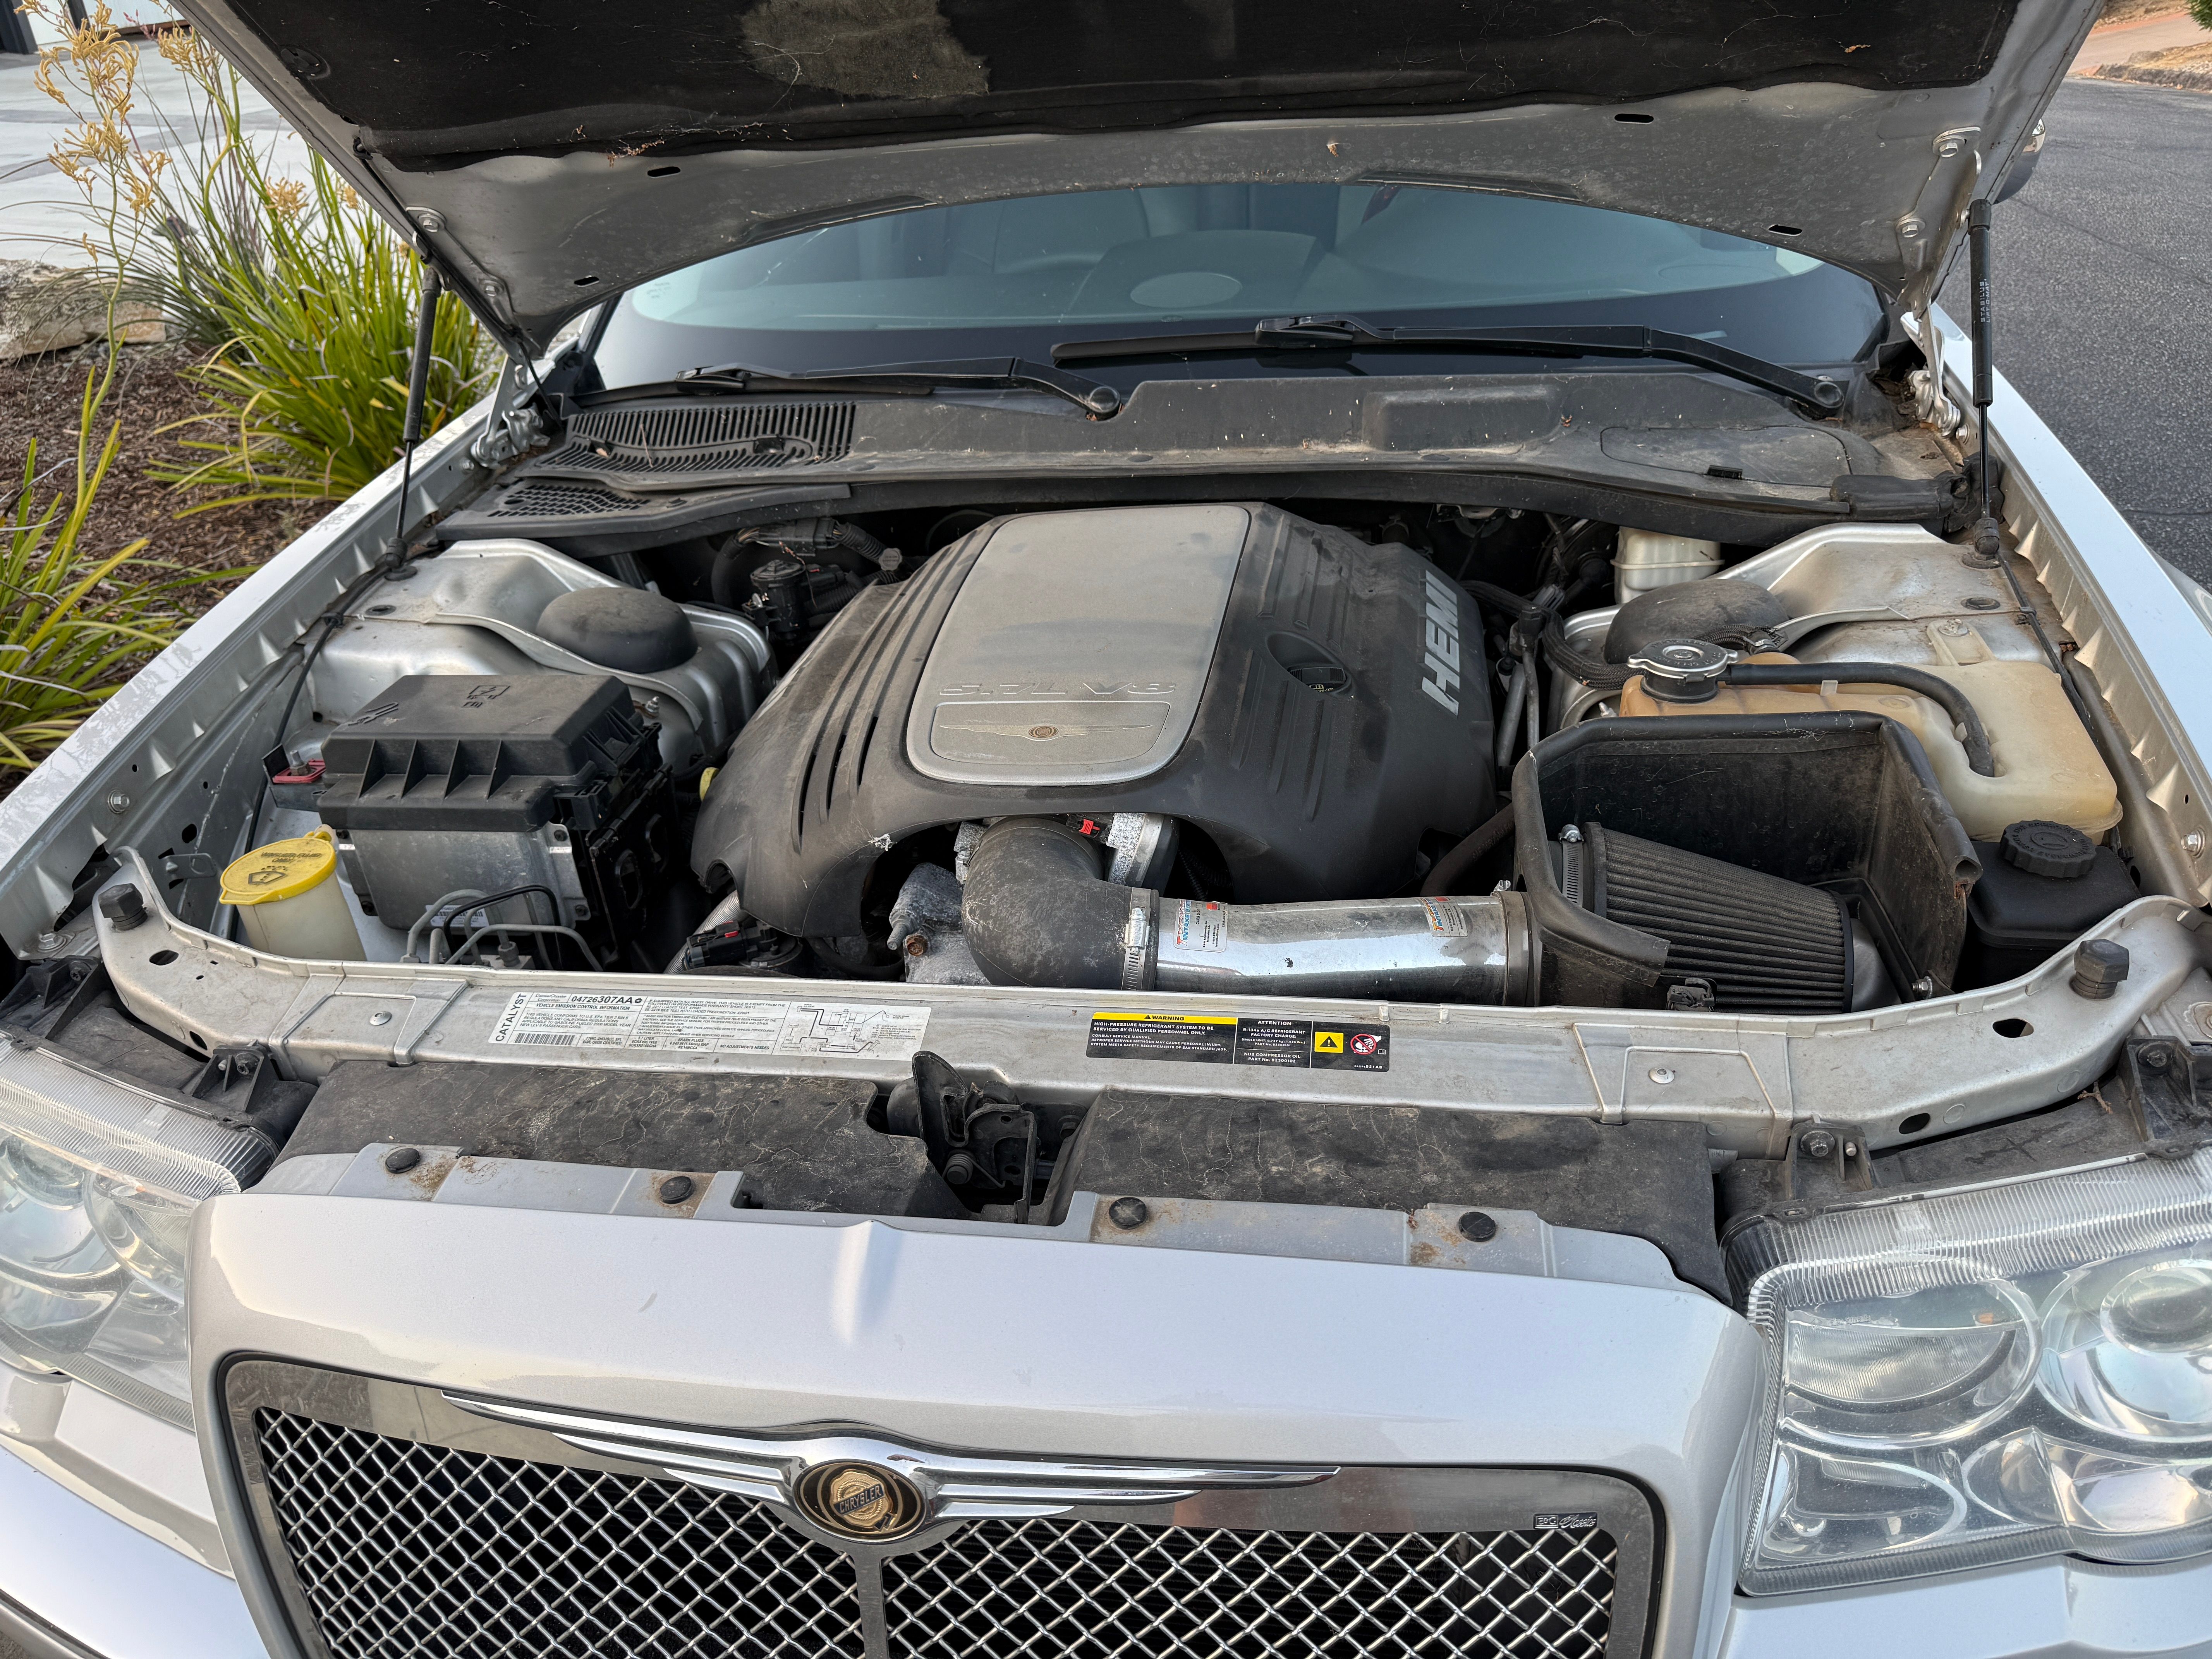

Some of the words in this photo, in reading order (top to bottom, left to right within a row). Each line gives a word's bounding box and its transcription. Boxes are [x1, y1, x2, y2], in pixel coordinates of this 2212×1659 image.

[1422, 570, 1460, 716] HEMI
[939, 682, 1069, 696] 5.7L
[1082, 681, 1177, 695] V8
[1431, 905, 1443, 926] INTAKE
[572, 994, 632, 1005] 04726307AA
[495, 993, 527, 1042] CATALYST
[838, 1485, 883, 1512] CHRYSLER
[1537, 1517, 1557, 1525] E&G
